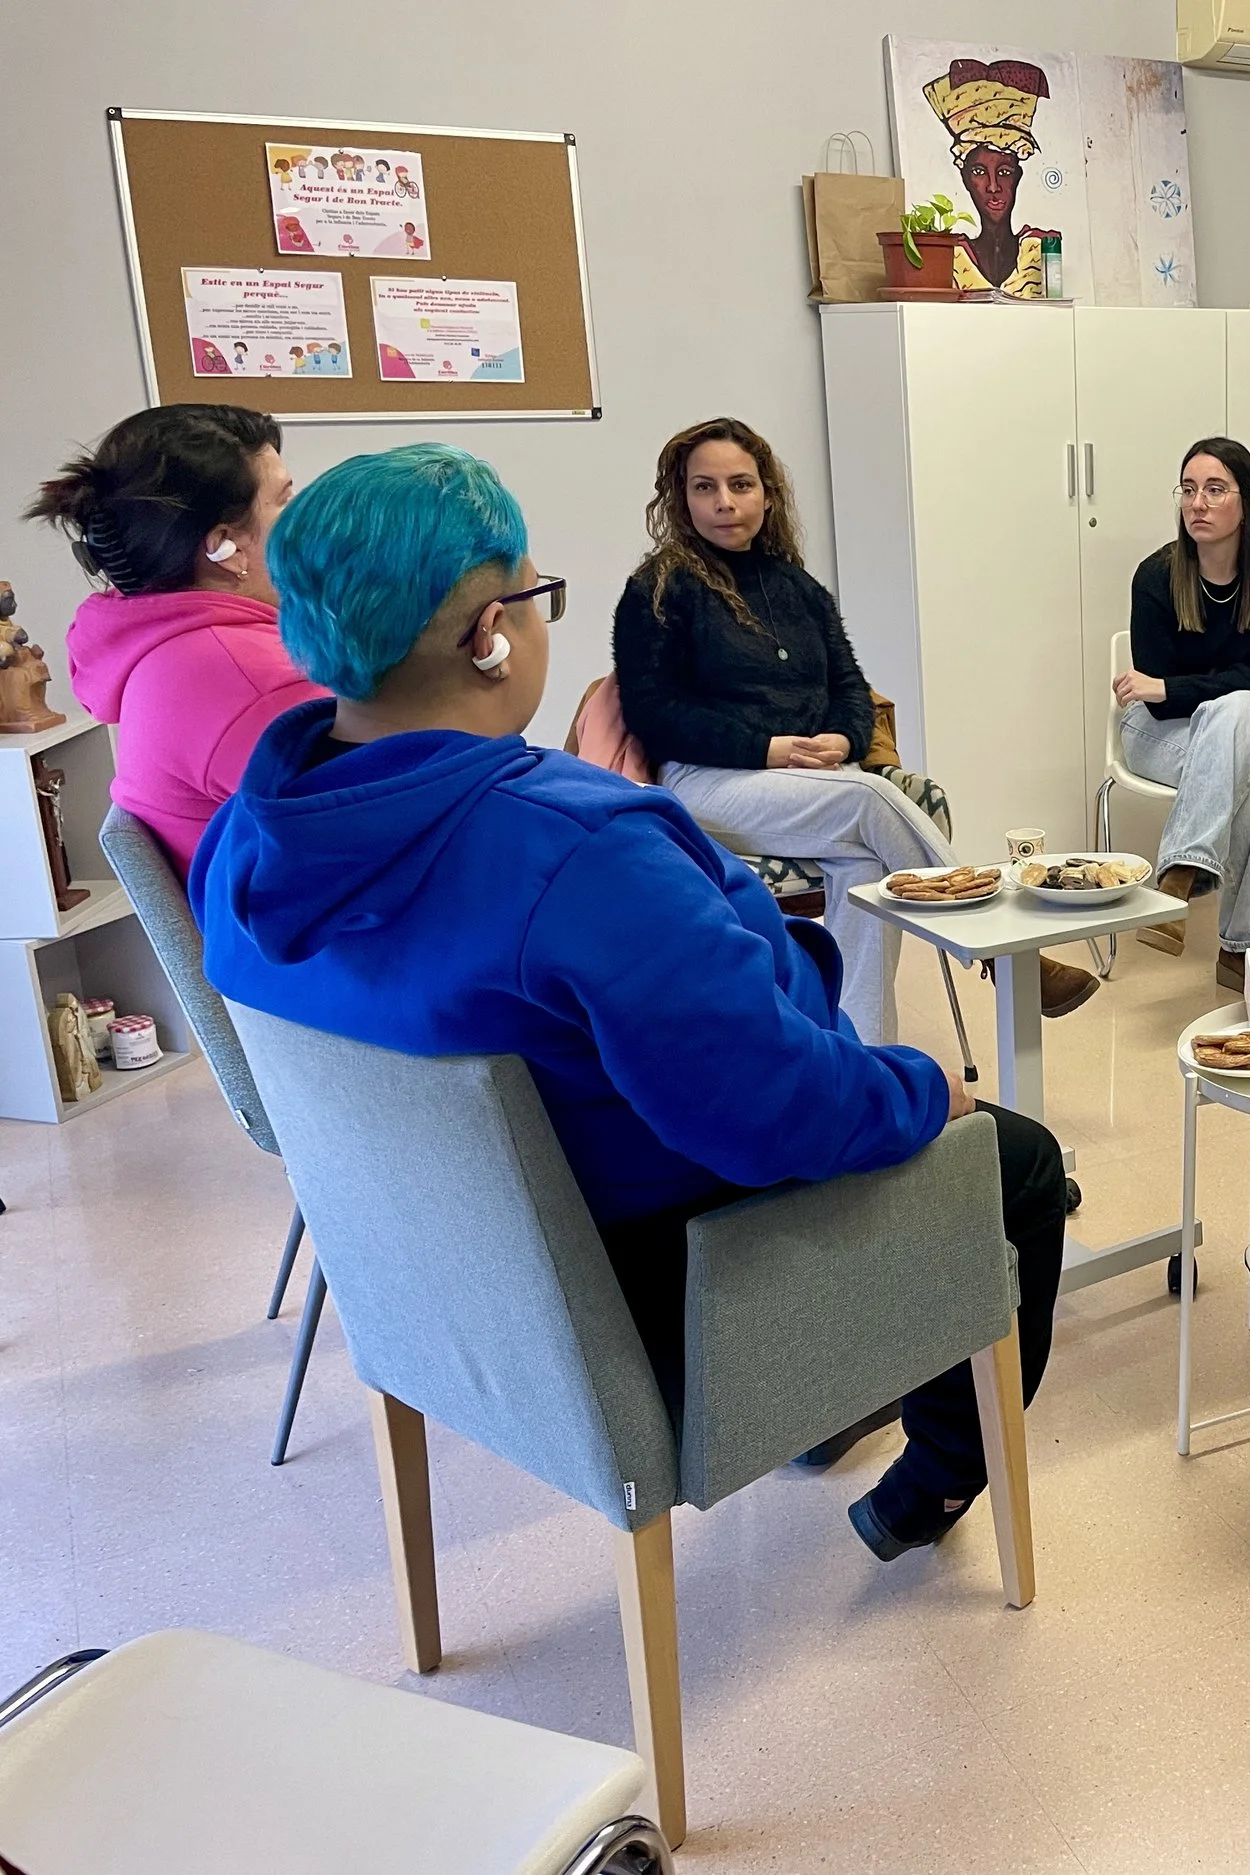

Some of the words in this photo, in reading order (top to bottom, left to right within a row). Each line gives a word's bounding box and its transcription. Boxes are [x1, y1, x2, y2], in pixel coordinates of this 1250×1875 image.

[300, 184, 334, 193] Aquest
[367, 188, 395, 198] Espai
[293, 194, 323, 203] Segur
[332, 195, 344, 203] de
[370, 198, 403, 207] Tracte.
[201, 278, 227, 287] Estic
[230, 279, 243, 287] en
[262, 280, 292, 290] Espai
[293, 281, 324, 291] Segur
